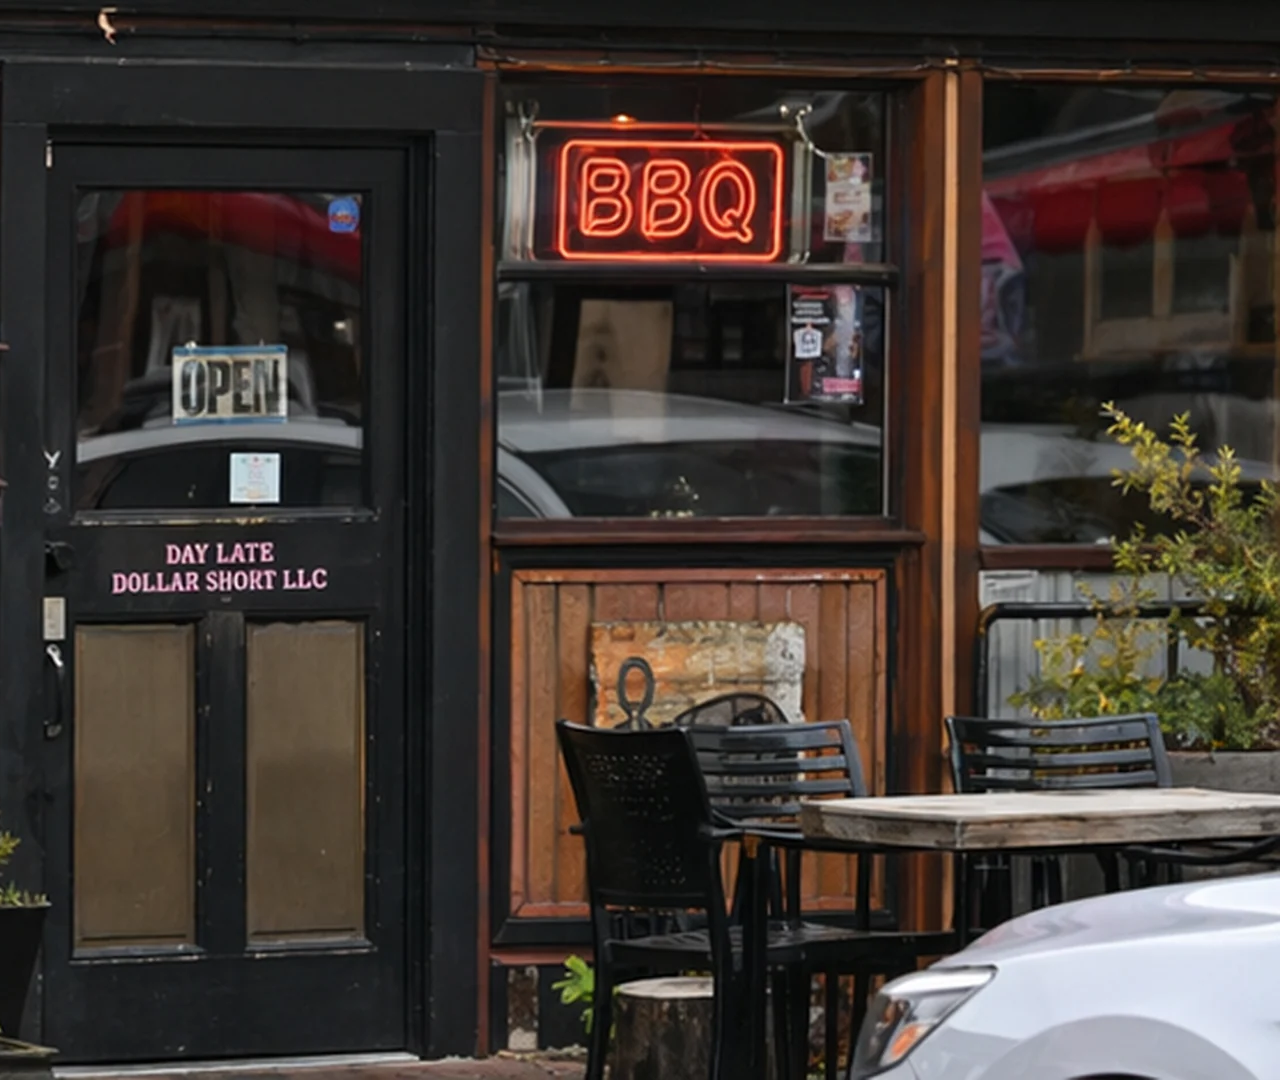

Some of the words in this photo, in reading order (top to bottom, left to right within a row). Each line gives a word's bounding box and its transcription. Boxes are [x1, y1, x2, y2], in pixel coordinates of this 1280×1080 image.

[578, 156, 757, 243] BBQ
[181, 358, 280, 417] OPEN
[166, 544, 209, 565] DAY
[215, 542, 275, 564] LATE
[111, 571, 200, 594] DOLLAR
[205, 569, 277, 592] SHORT
[282, 568, 328, 590] LLC
